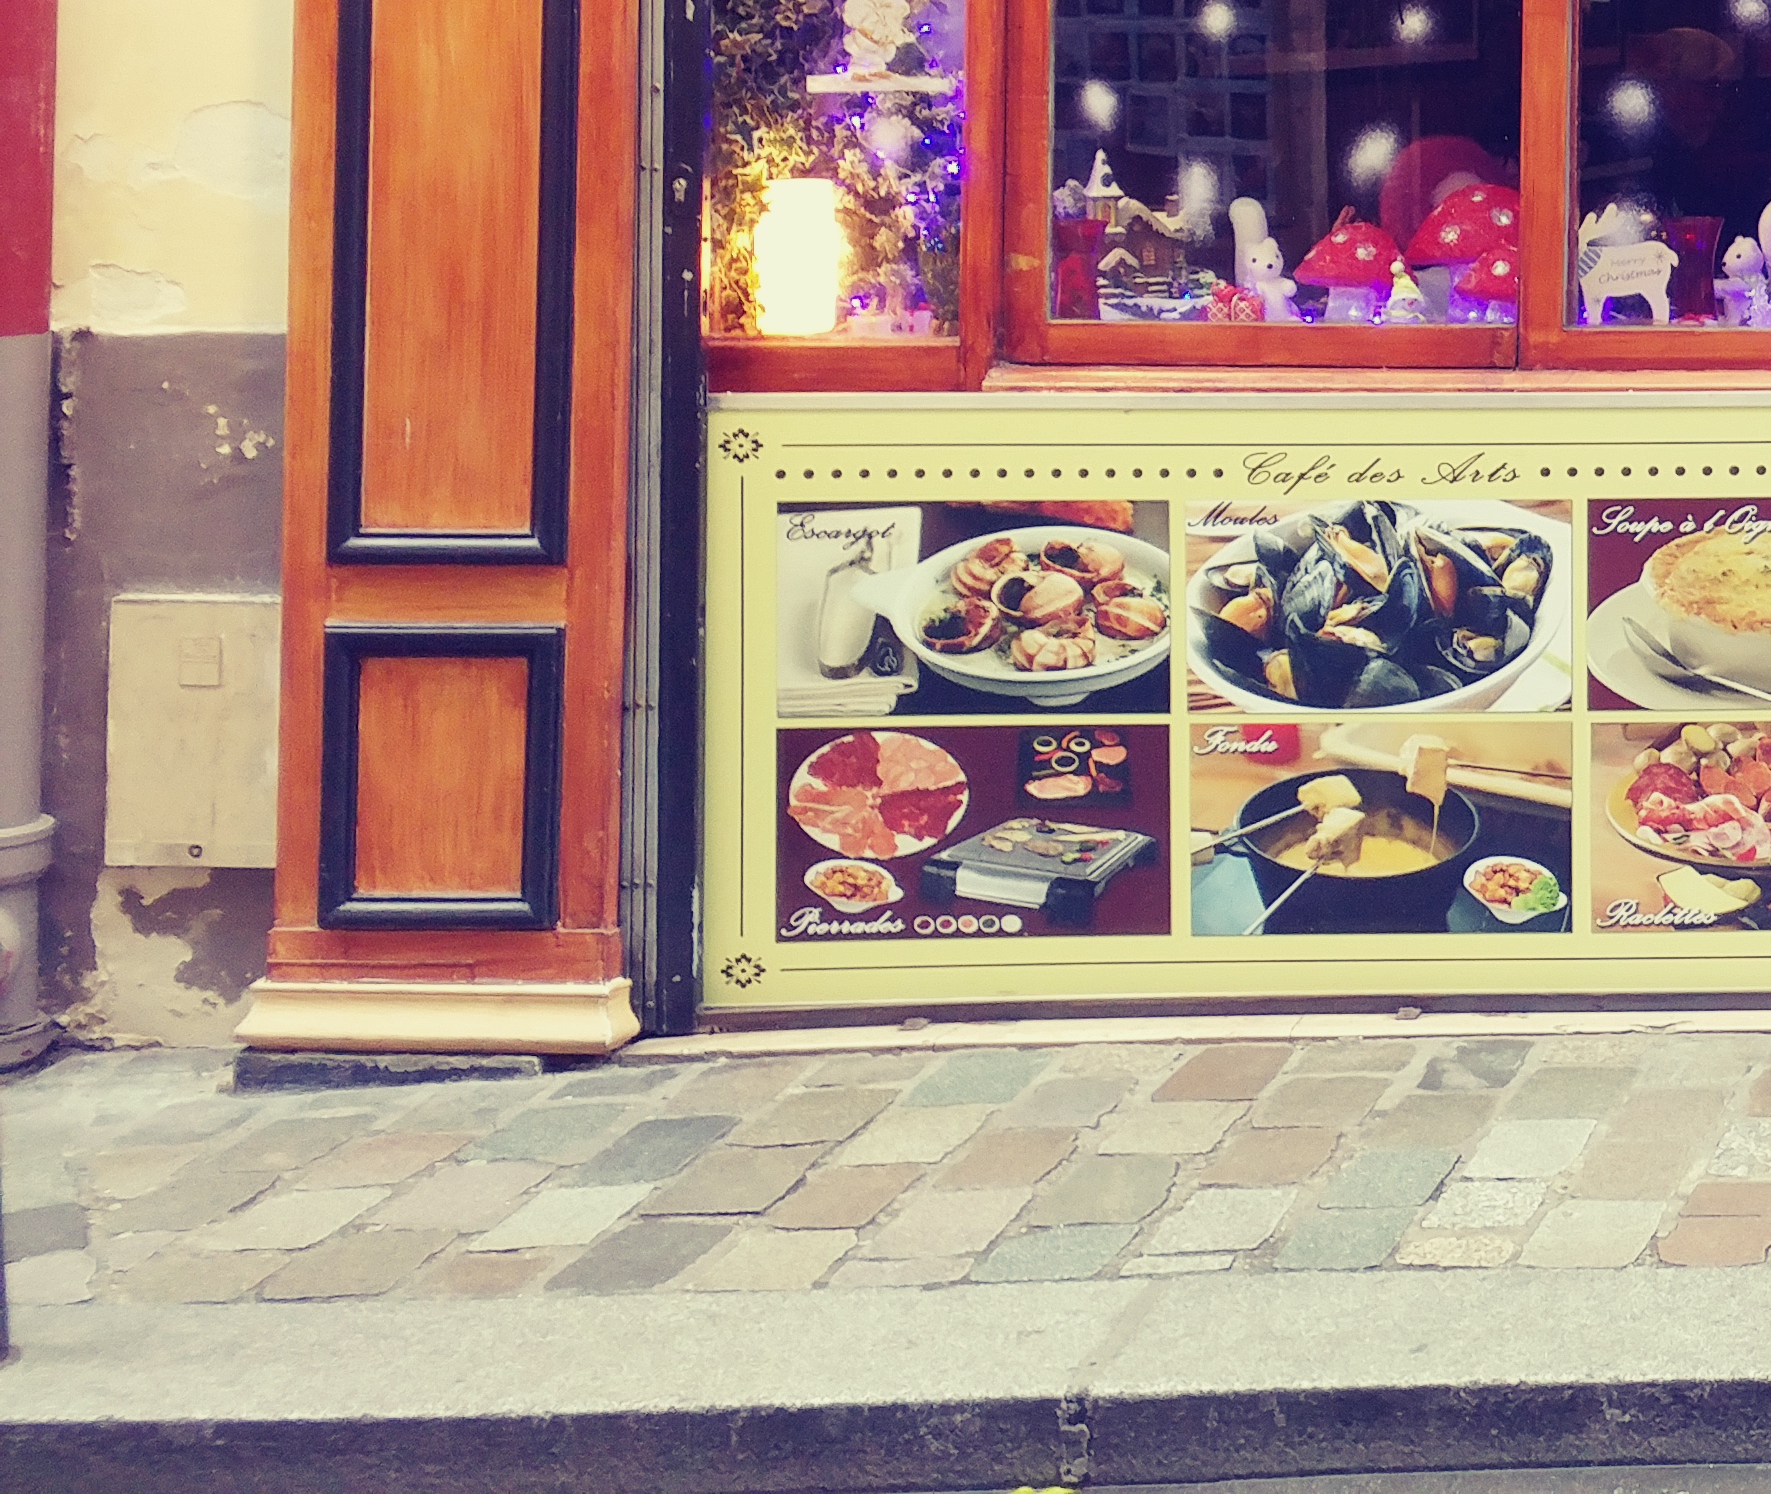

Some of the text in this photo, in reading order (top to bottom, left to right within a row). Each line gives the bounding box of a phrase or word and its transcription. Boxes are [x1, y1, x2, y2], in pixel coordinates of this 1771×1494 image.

[1242, 451, 1521, 495] Café des Arts
[785, 514, 895, 548] Escargot
[1186, 501, 1281, 529] Moules
[1592, 505, 1674, 543] Soupe
[1679, 514, 1697, 533] à
[1192, 727, 1278, 756] Fondu
[779, 906, 905, 938] Pierrades
[1596, 898, 1718, 930] Raclettes
